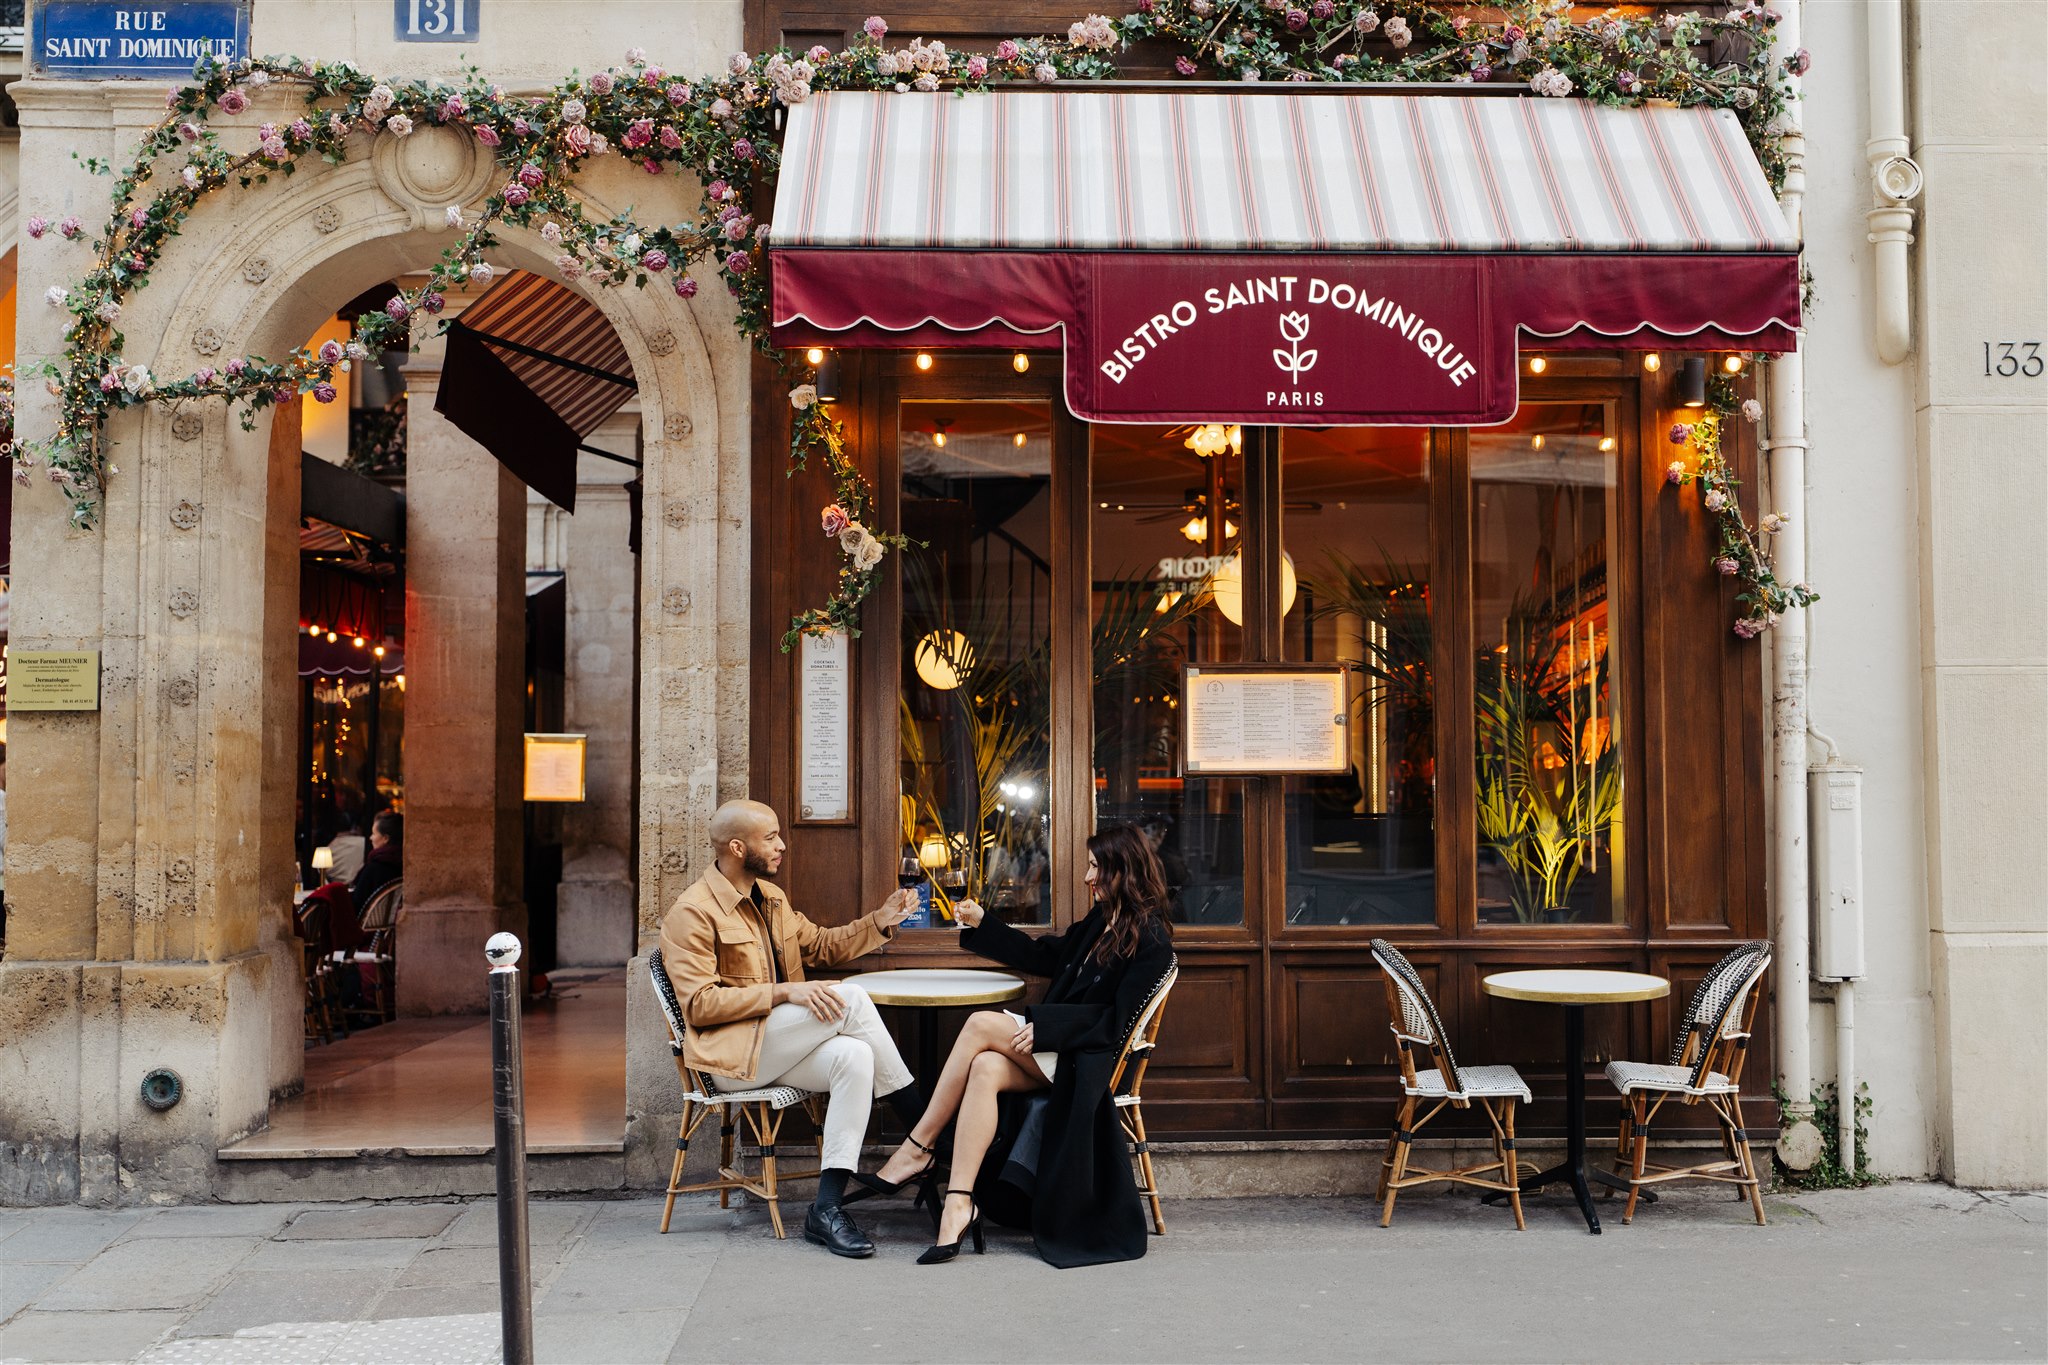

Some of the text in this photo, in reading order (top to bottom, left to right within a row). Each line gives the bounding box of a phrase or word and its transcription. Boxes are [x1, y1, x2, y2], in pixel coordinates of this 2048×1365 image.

[114, 11, 166, 31] RUE
[407, 0, 466, 35] 131
[46, 37, 235, 59] SAINT DOMINIQUE
[1099, 276, 1478, 387] BISTRO SAINT DOMINIQUE
[1983, 341, 2044, 377] 133
[1266, 391, 1324, 406] PARIS
